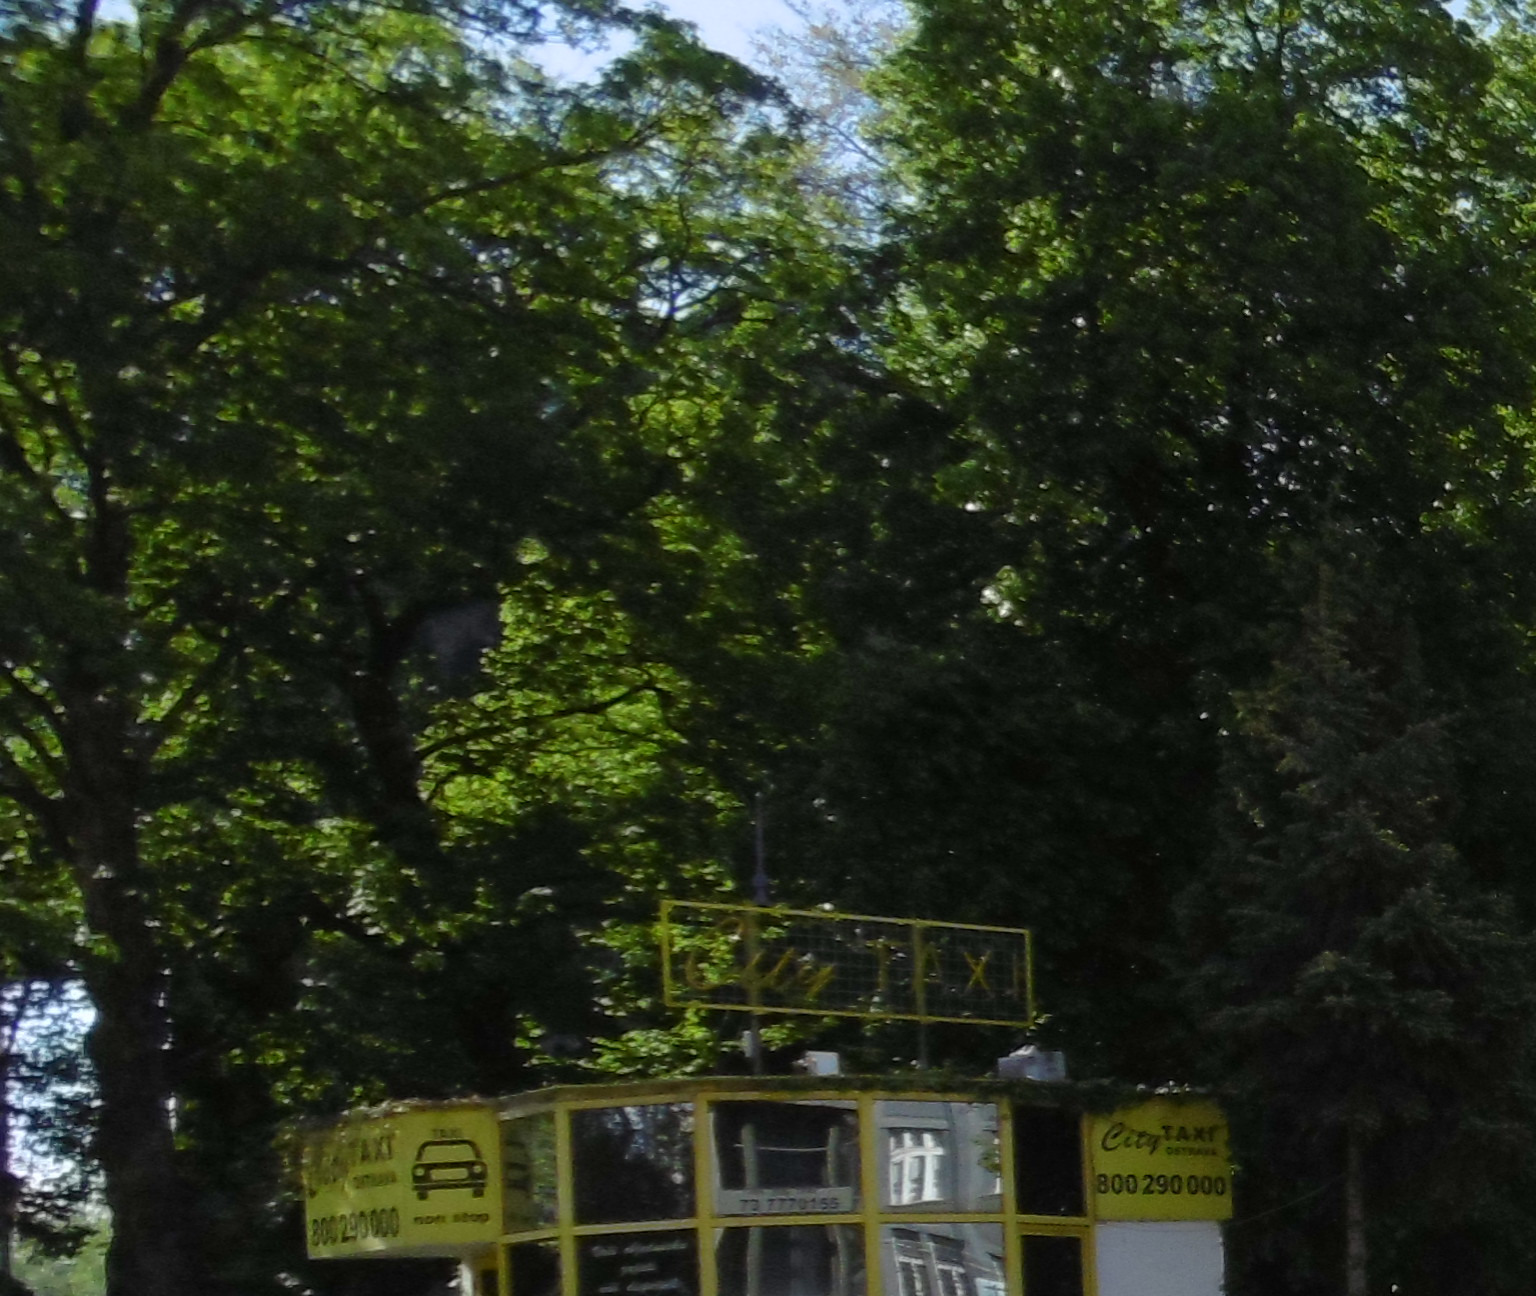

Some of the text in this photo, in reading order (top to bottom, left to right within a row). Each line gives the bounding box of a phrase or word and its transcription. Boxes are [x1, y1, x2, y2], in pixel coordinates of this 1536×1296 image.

[1101, 1121, 1220, 1156] City TAXI
[1097, 1174, 1227, 1196] 800 290 000
